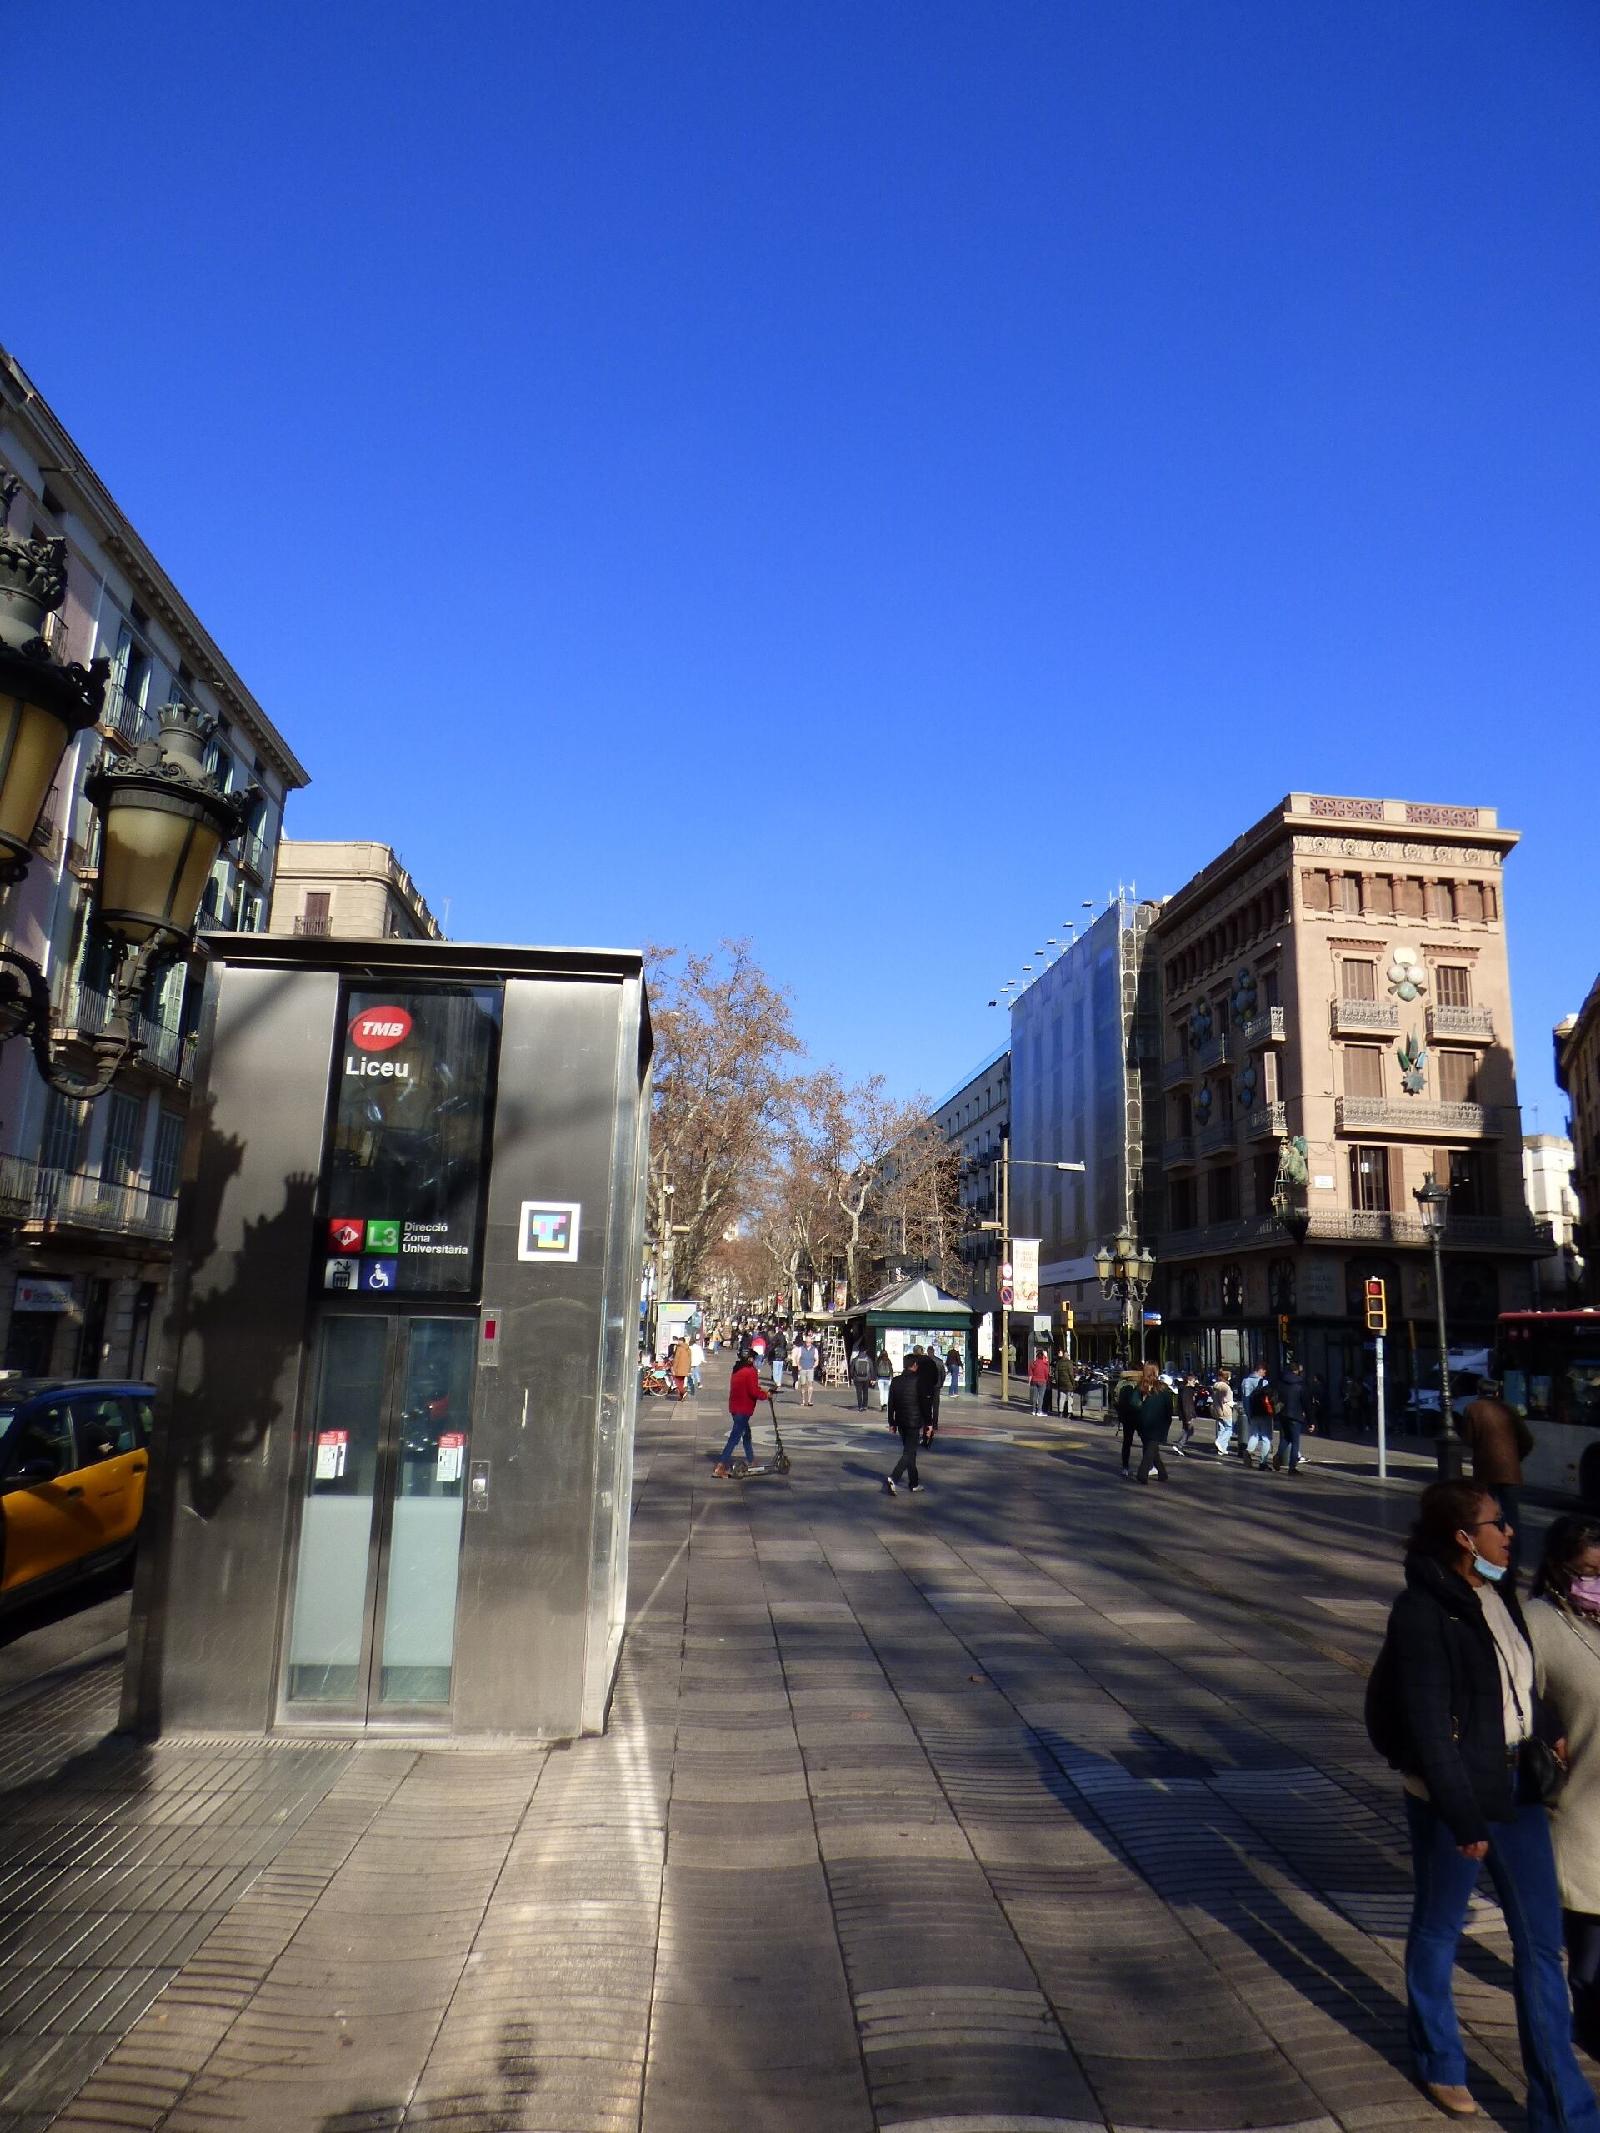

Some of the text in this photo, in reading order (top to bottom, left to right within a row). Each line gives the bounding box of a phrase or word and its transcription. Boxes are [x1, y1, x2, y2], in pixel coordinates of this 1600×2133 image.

[363, 1022, 403, 1037] TMB
[346, 1057, 409, 1077] Liceu
[404, 1222, 448, 1232] Direcció
[341, 1230, 352, 1240] M
[368, 1226, 397, 1247] L3
[403, 1233, 430, 1243] Zona
[403, 1244, 469, 1255] Universitària
